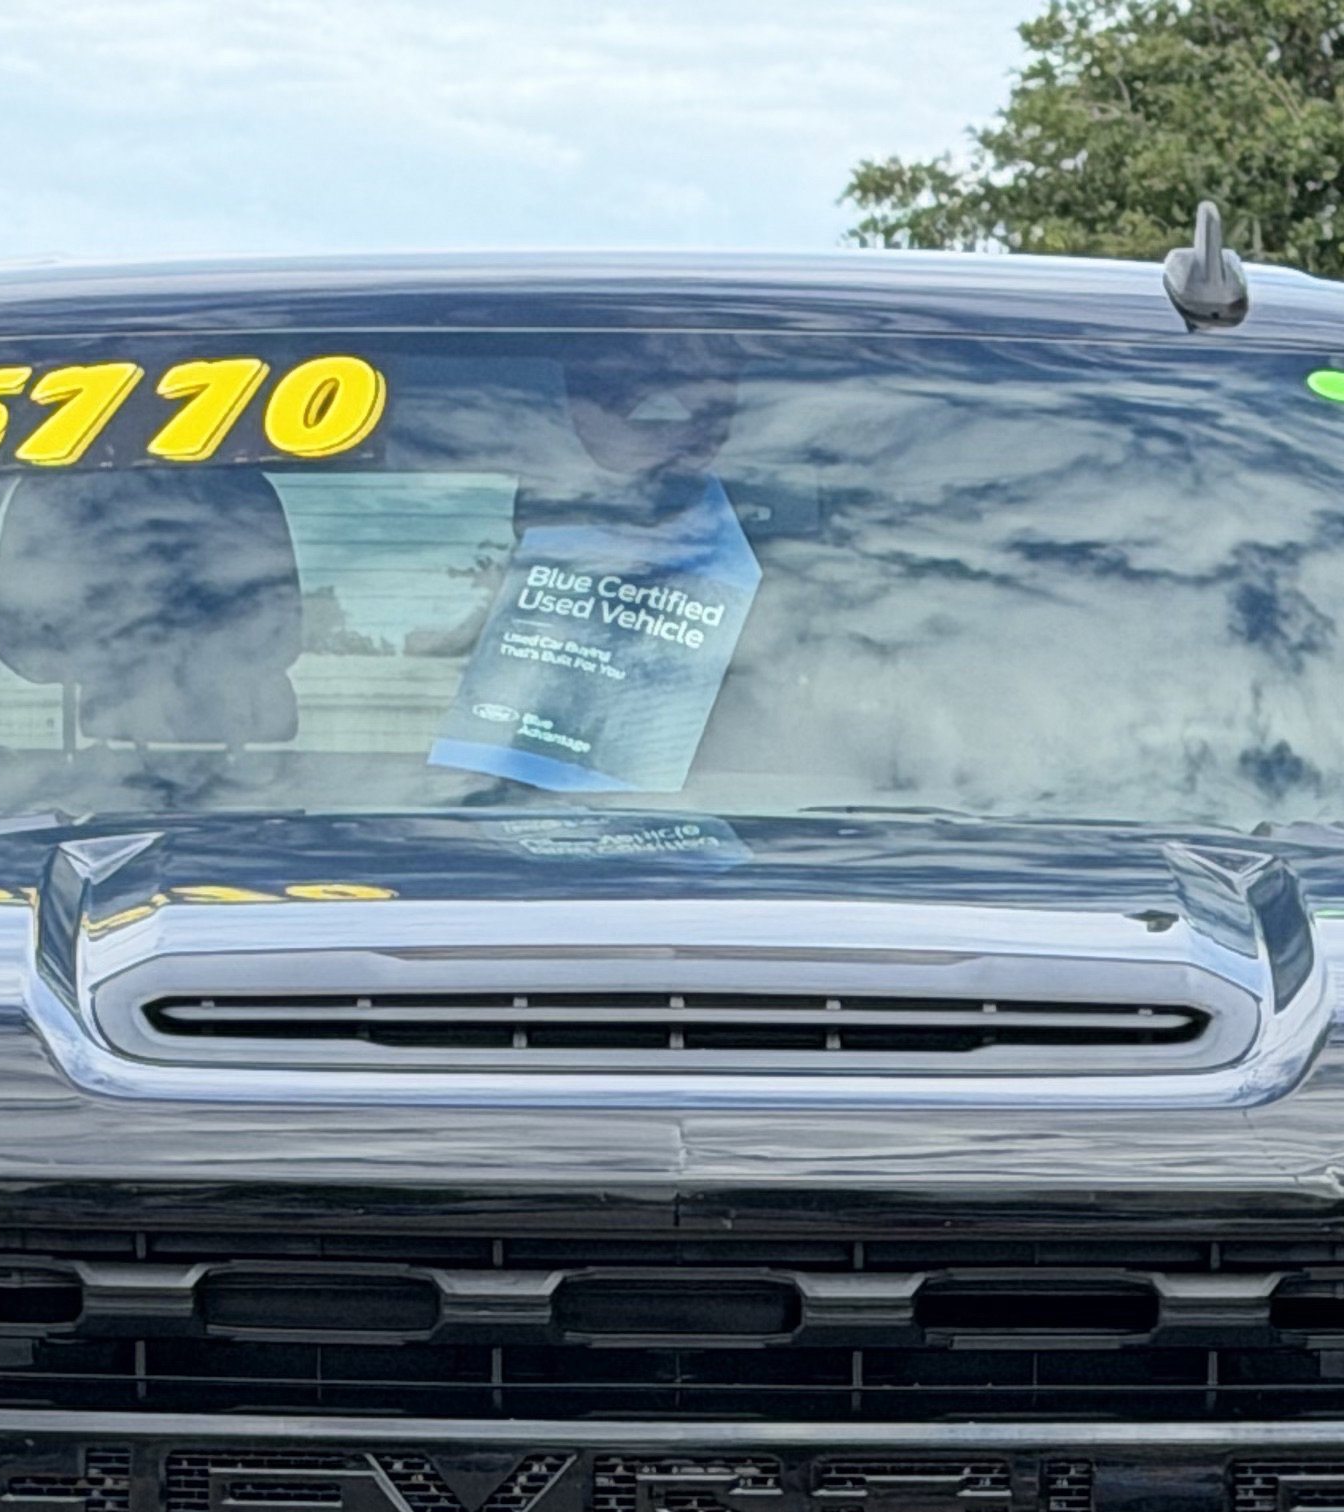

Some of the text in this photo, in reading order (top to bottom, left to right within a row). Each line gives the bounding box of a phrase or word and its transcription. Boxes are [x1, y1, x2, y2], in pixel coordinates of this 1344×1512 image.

[527, 565, 725, 627] Blue Certified
[518, 588, 704, 649] Used Vehicle
[503, 631, 540, 647] Used
[600, 663, 627, 680] You
